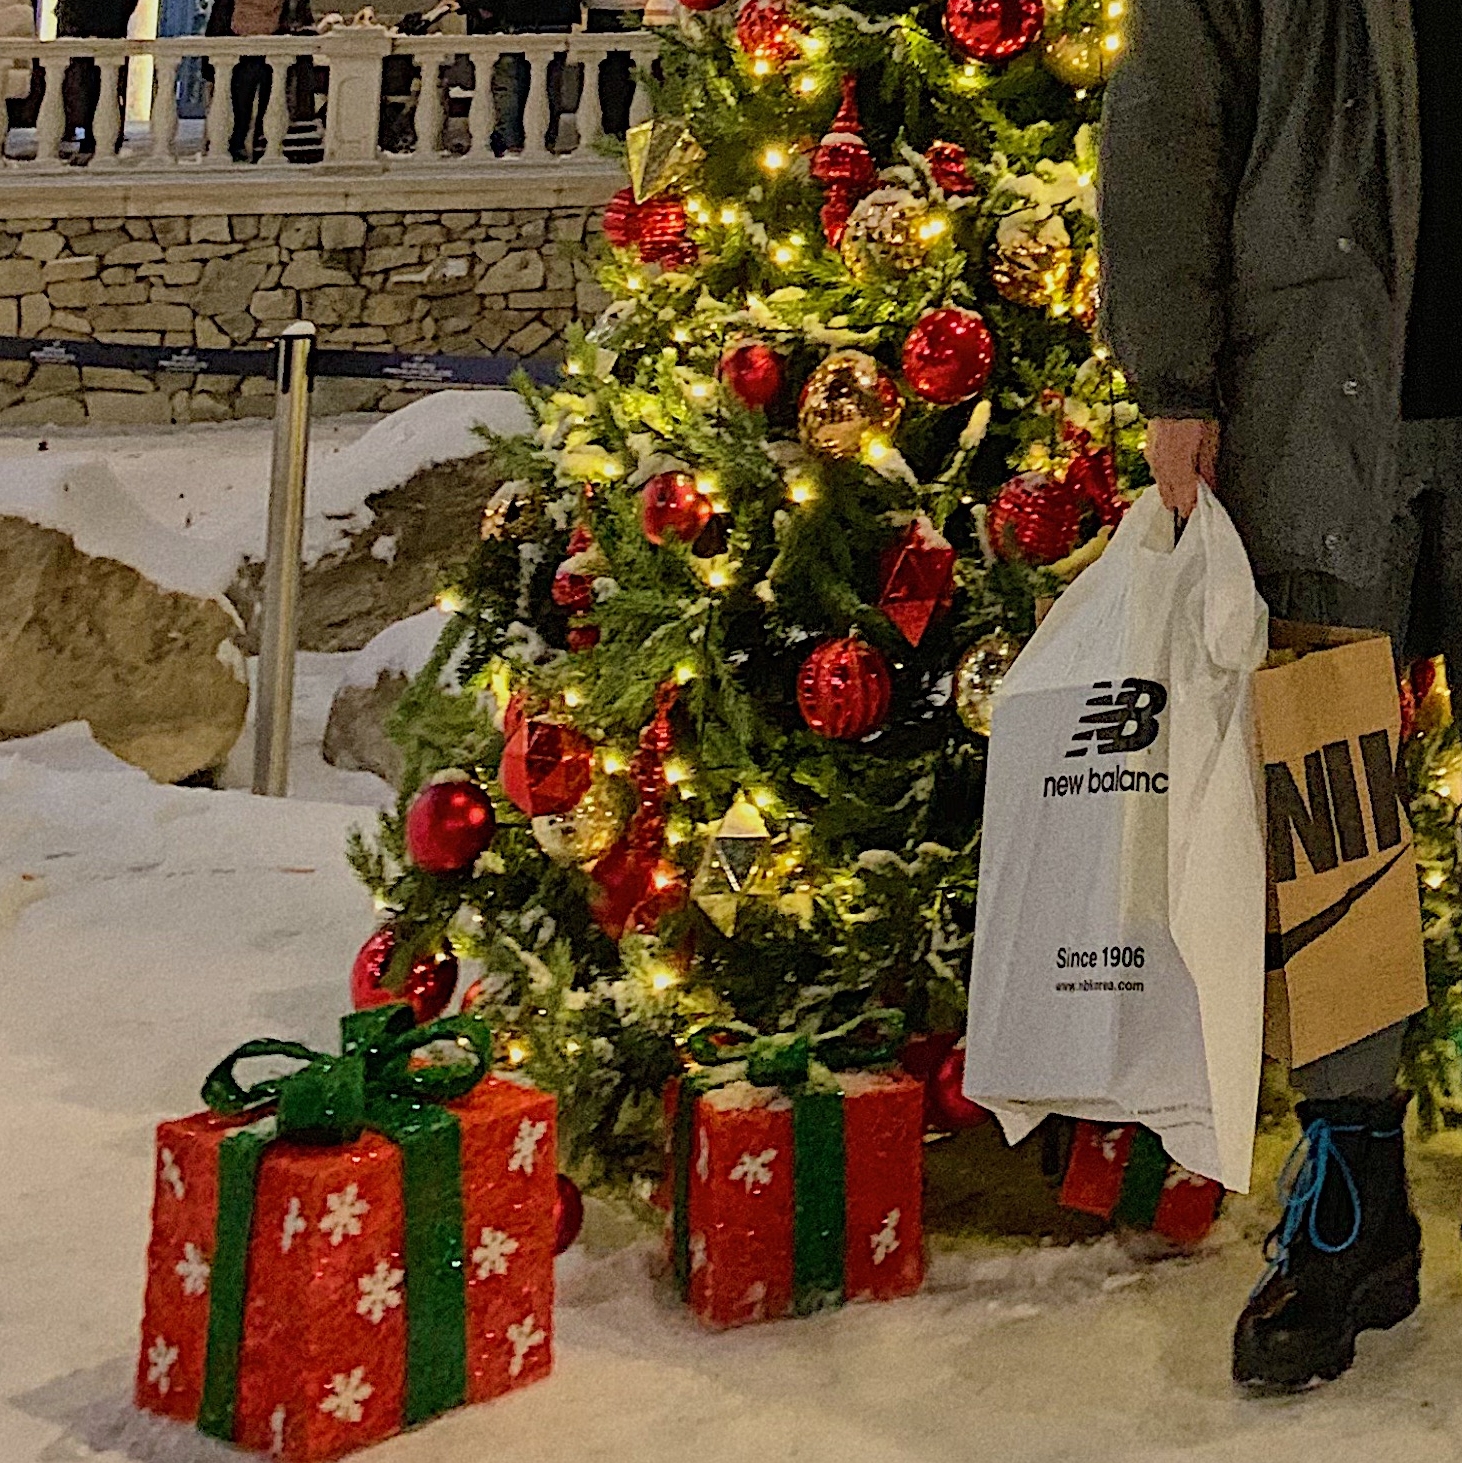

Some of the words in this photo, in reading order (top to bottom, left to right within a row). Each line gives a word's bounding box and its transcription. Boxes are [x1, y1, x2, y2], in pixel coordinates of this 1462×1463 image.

[1043, 774, 1084, 797] new
[1056, 946, 1097, 968] Since
[1102, 946, 1145, 968] 1906
